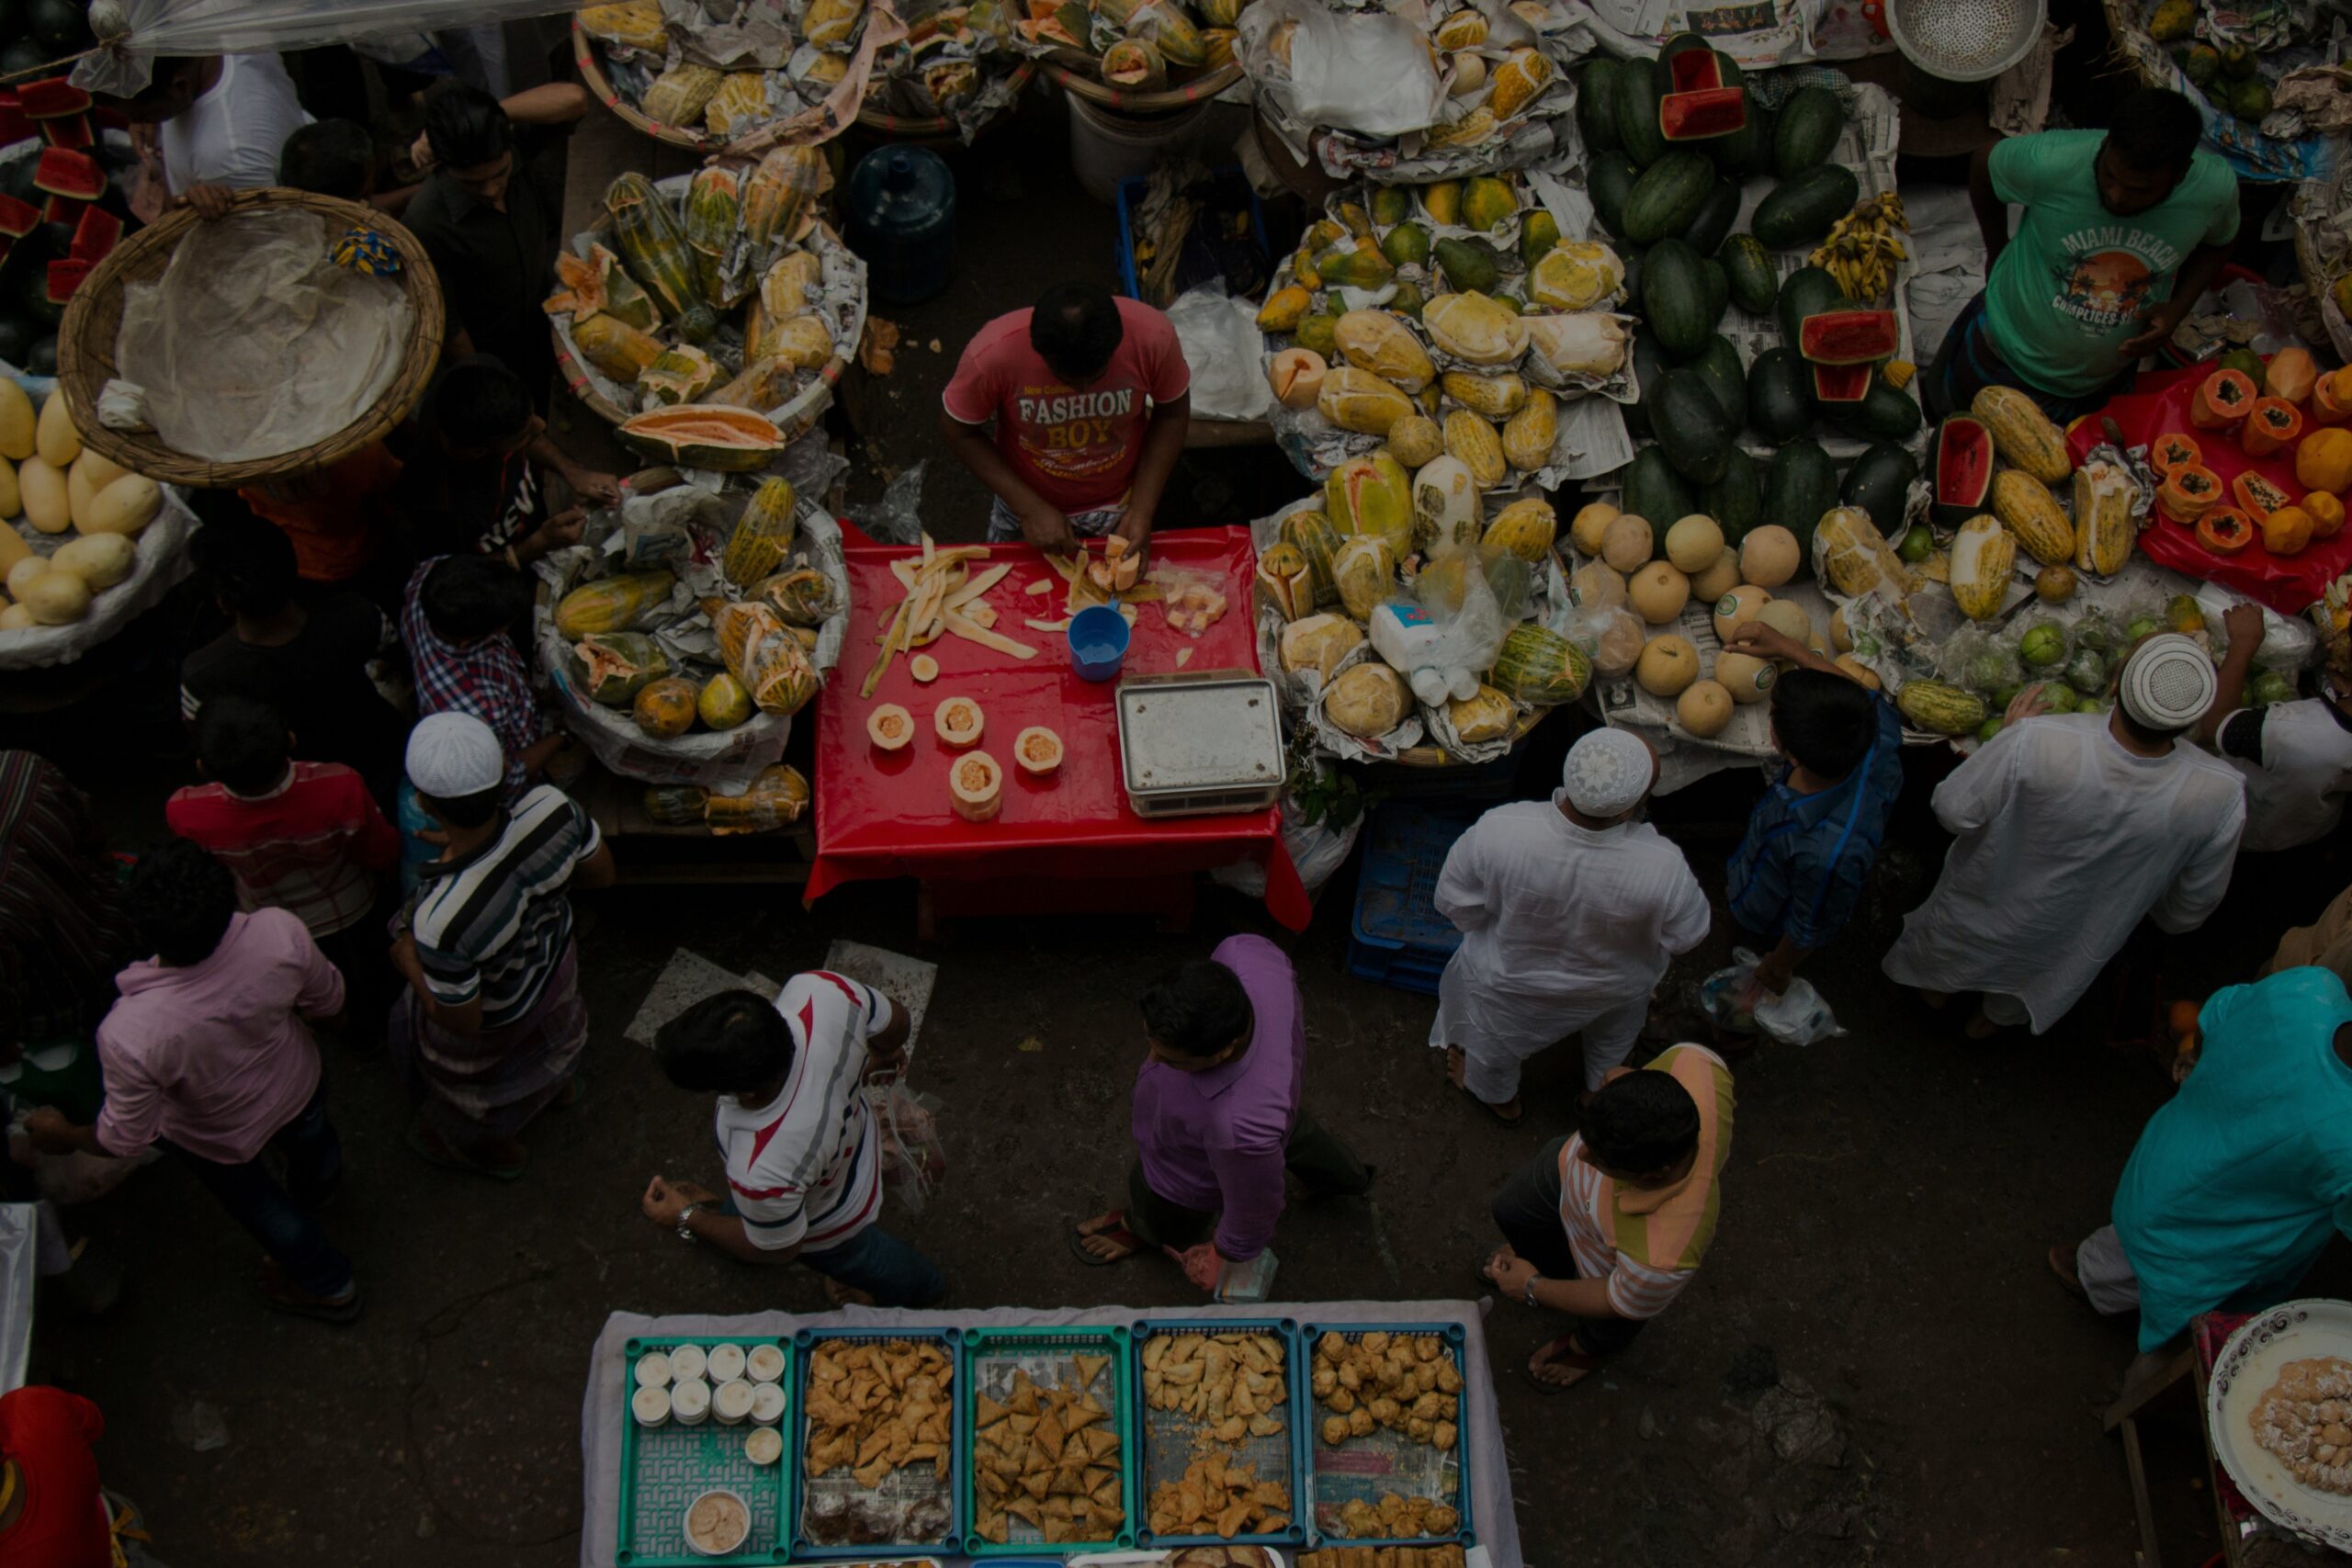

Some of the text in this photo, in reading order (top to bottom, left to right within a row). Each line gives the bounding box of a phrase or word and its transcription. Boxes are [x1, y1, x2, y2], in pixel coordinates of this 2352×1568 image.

[2061, 226, 2179, 270] MIAMI BEACH
[2052, 294, 2117, 325] COMPLICES
[1019, 389, 1132, 424] FASHION
[1047, 418, 1113, 448] BOY
